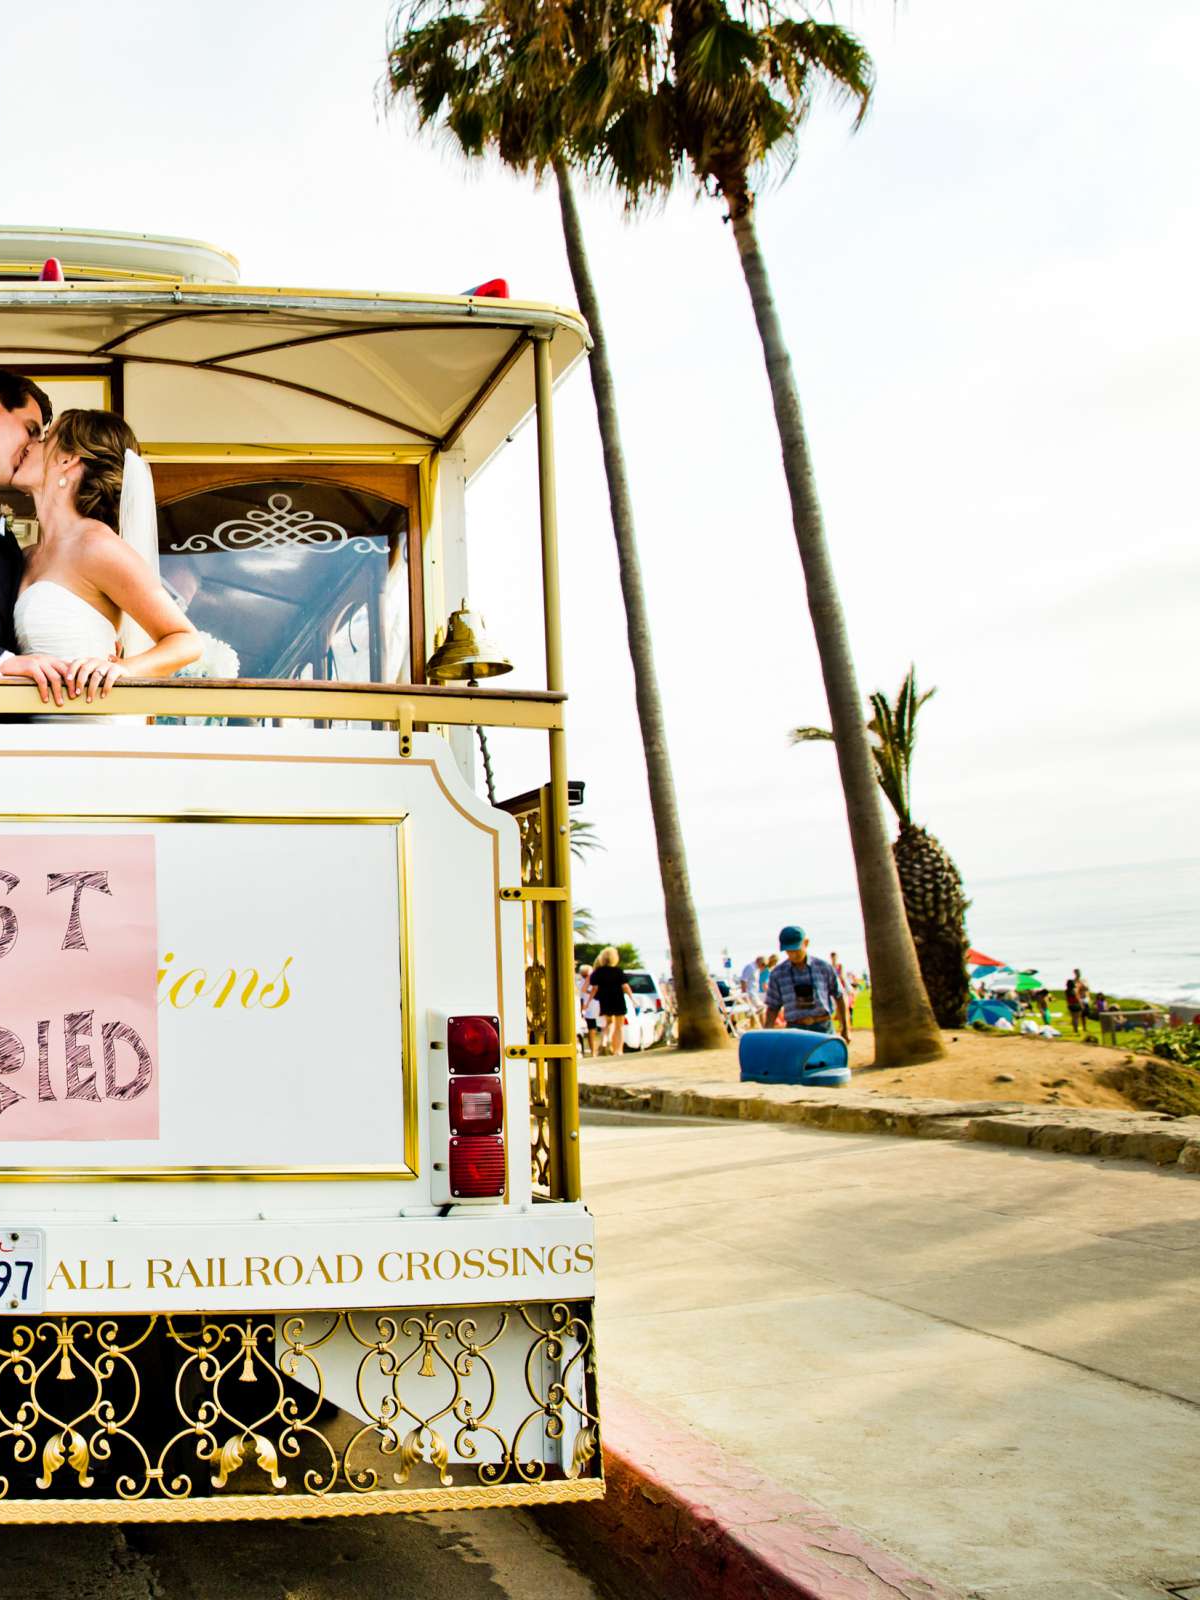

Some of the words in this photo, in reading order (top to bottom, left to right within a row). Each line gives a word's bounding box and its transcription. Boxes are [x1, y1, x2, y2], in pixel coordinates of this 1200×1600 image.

[157, 952, 294, 1009] ions
[47, 1258, 131, 1291] ALL
[147, 1253, 363, 1289] RAILROAD
[377, 1243, 595, 1281] CROSSINGS
